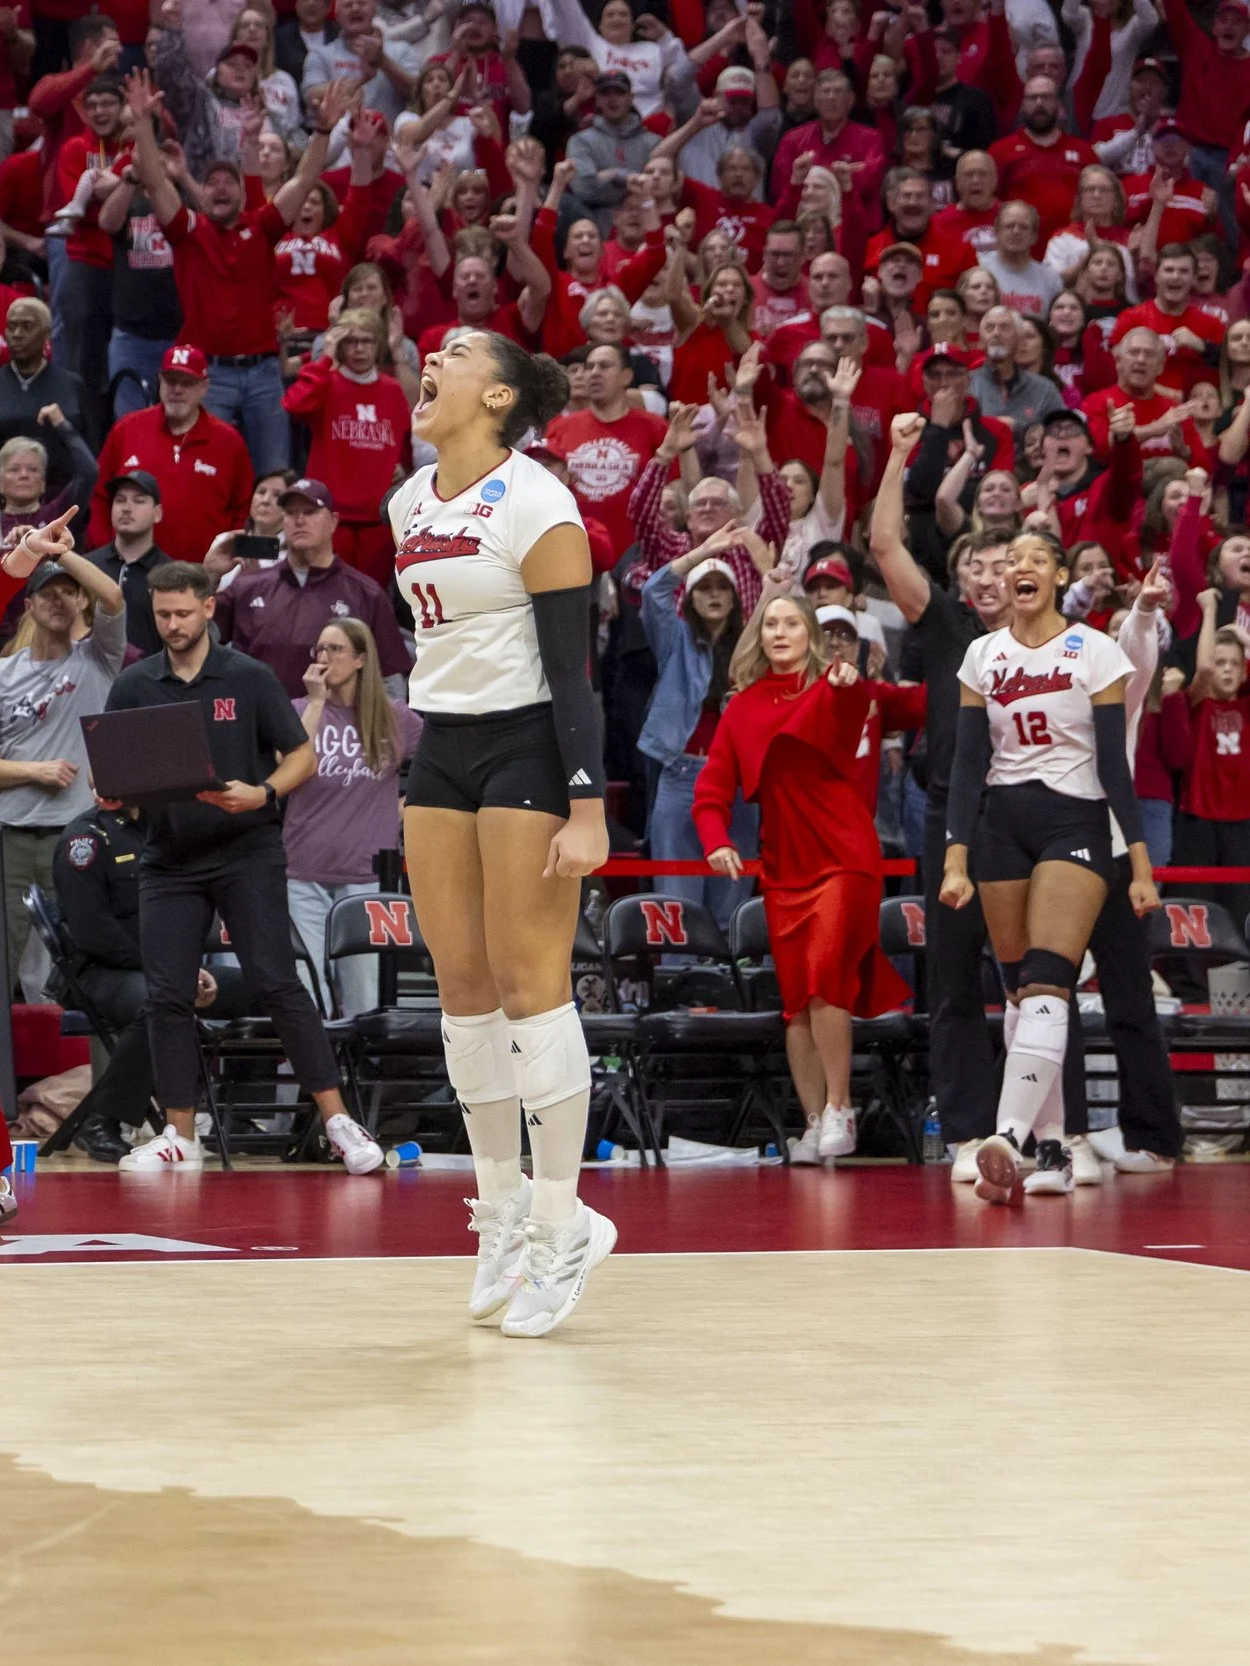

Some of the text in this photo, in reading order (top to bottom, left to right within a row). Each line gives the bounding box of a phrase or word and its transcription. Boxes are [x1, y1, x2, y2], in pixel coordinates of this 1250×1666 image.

[291, 250, 316, 275] N
[171, 350, 190, 365] N
[356, 403, 377, 423] N
[411, 582, 444, 629] 11
[213, 698, 237, 720] N
[1012, 710, 1053, 746] 12
[1216, 731, 1241, 755] N
[364, 900, 416, 947] N
[639, 900, 689, 945] N
[1165, 904, 1213, 948] N
